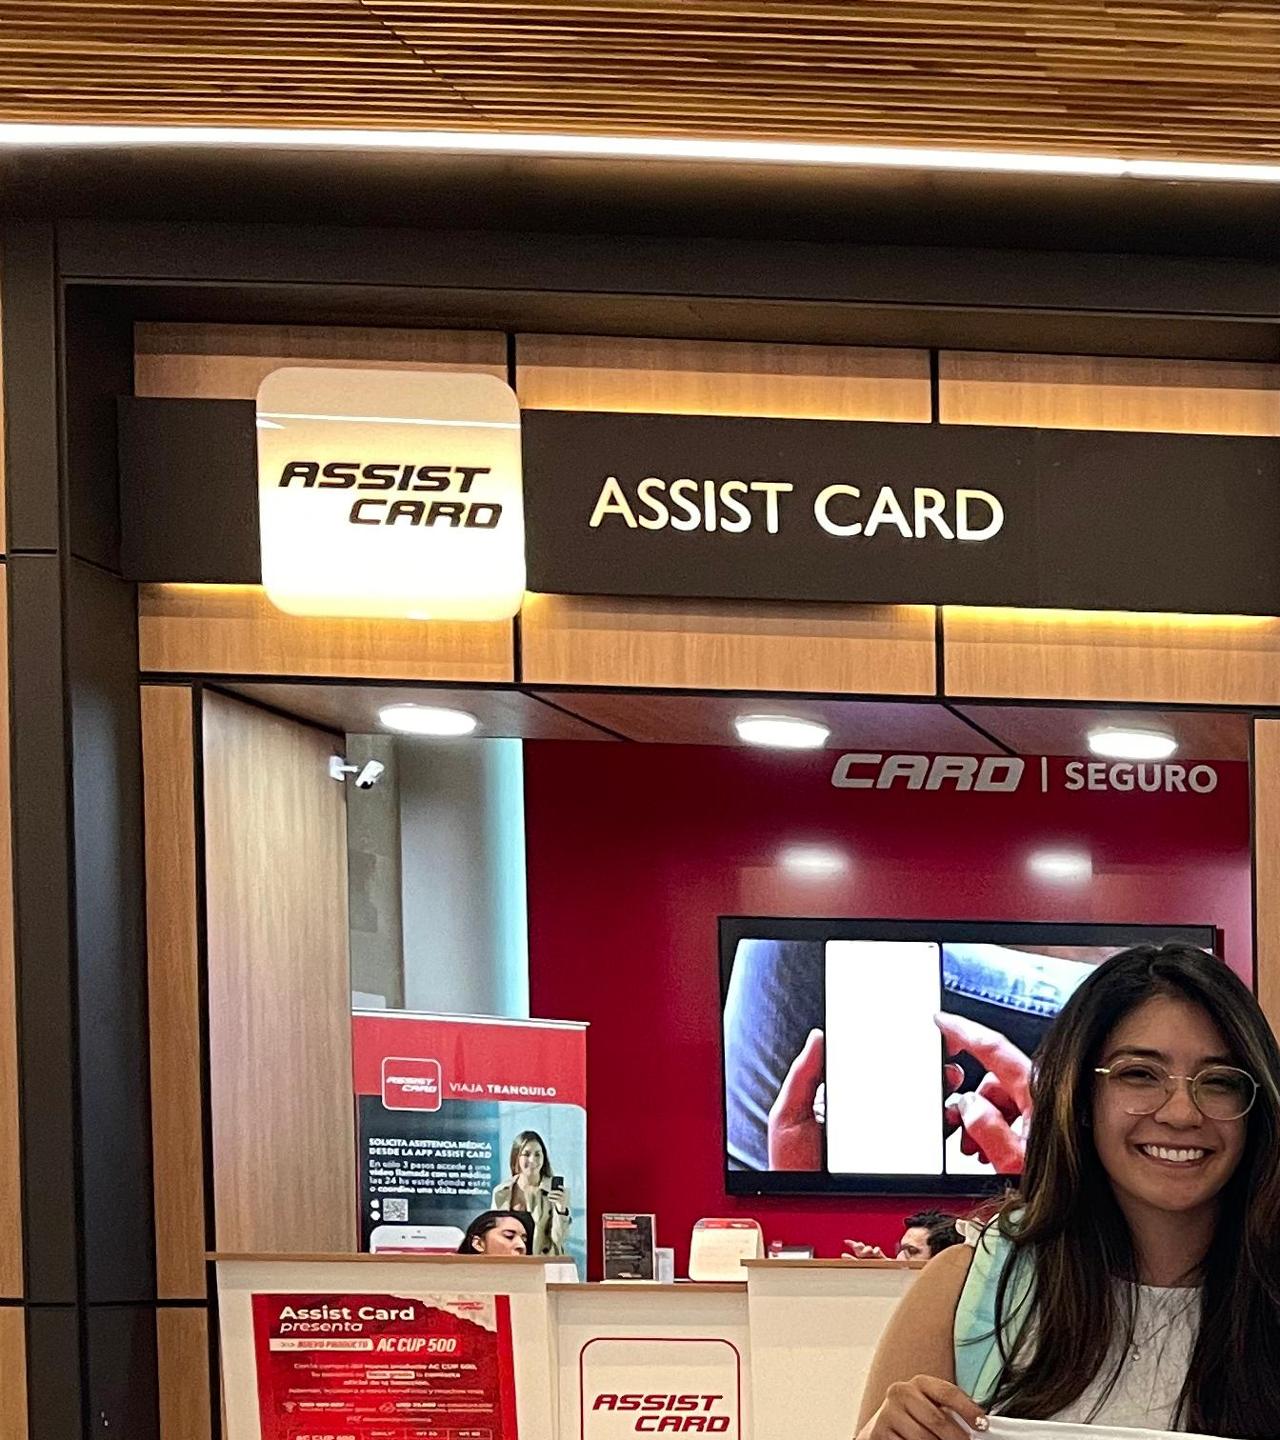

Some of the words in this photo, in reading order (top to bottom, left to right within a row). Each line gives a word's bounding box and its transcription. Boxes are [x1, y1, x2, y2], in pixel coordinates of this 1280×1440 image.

[278, 461, 491, 493] ASSIST
[349, 499, 502, 529] CARD
[589, 476, 794, 534] ASSIST
[813, 484, 1005, 541] CARD
[831, 753, 1025, 792] CARD
[1064, 762, 1218, 794] SEGURO
[449, 1082, 484, 1093] VIAJA
[487, 1084, 557, 1097] TRANQUILO
[369, 1138, 407, 1147] SOLICITA
[408, 1139, 457, 1149] ASISTENCIA
[369, 1148, 399, 1156] DESDE
[415, 1149, 433, 1157] APP
[435, 1149, 464, 1158] ASSIST
[466, 1150, 492, 1159] CARD
[369, 1160, 381, 1168] En
[403, 1161, 409, 1169] 3
[384, 1177, 396, 1185] 24
[279, 1305, 352, 1320] Assist
[358, 1306, 415, 1320] Card
[279, 1320, 363, 1333] presenta
[376, 1338, 397, 1352] AC
[397, 1338, 427, 1352] CUP
[427, 1338, 457, 1352] 500
[592, 1394, 723, 1411] ASSIST
[634, 1415, 730, 1432] CARD
